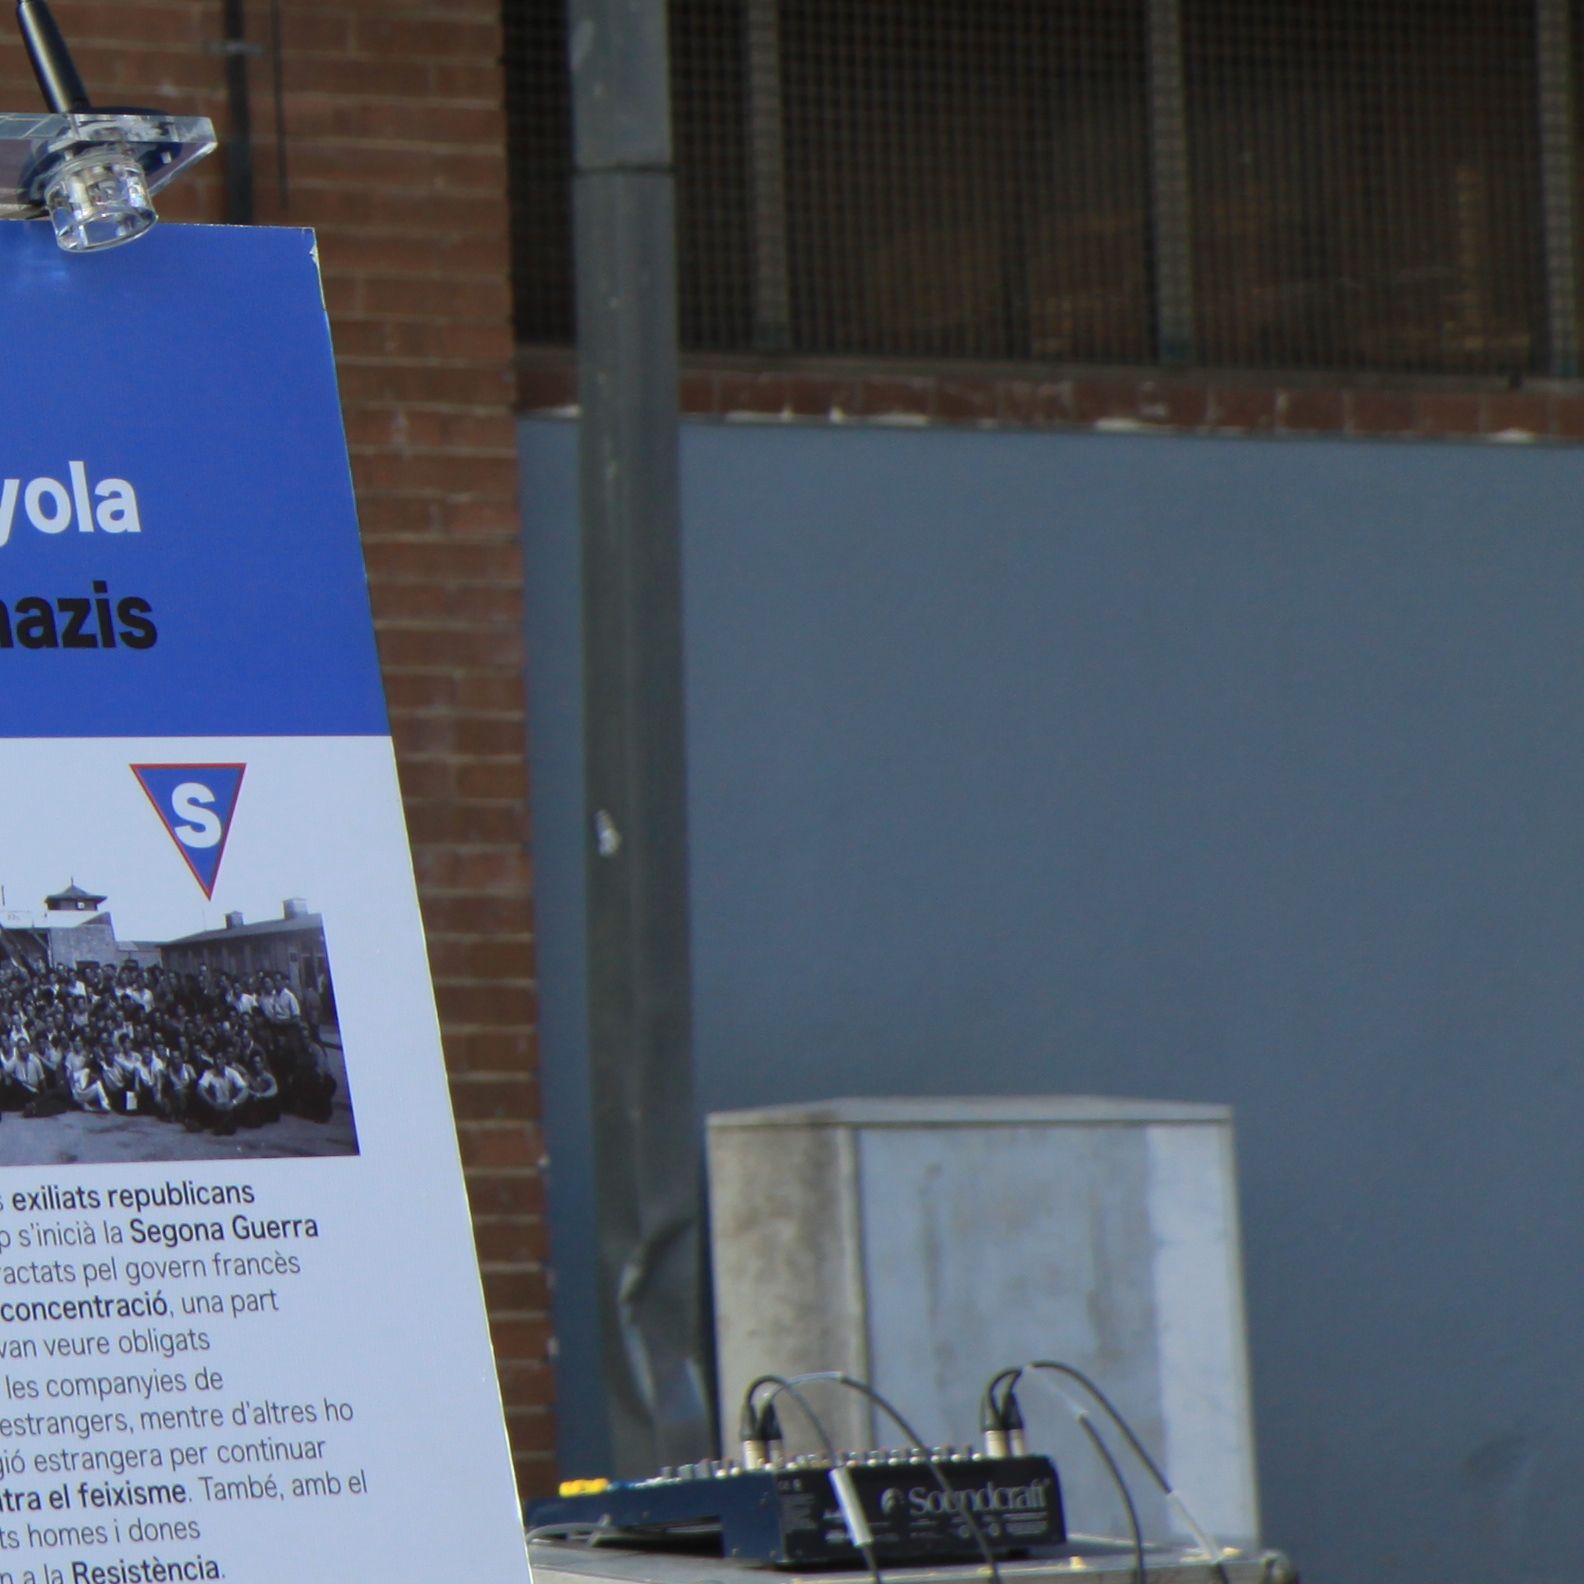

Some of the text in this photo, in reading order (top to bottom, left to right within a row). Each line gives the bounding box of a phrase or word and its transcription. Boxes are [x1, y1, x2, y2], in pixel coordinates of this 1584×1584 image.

[170, 782, 223, 848] S
[12, 1183, 101, 1212] exiliats
[107, 1180, 256, 1212] republicans
[19, 1220, 97, 1248] s'inicià
[103, 1220, 123, 1244] la
[129, 1217, 224, 1248] Segona
[231, 1215, 319, 1240] Guerra
[83, 1256, 118, 1287] pel
[125, 1259, 207, 1286] govern
[212, 1250, 301, 1277] francès
[0, 1289, 175, 1322] concentració,
[182, 1293, 224, 1314] una
[231, 1288, 279, 1318] part
[43, 1334, 110, 1357] veure
[118, 1328, 211, 1358] obligats
[5, 1375, 39, 1400] les
[46, 1368, 187, 1401] companyies
[194, 1366, 223, 1391] de
[0, 1412, 135, 1440] estrangers,
[140, 1405, 224, 1430] mentre
[231, 1400, 317, 1426] d'altres
[323, 1397, 354, 1421] ho
[33, 1447, 163, 1475] estrangera
[170, 1445, 208, 1471] per
[217, 1436, 326, 1464] continuar
[48, 1483, 70, 1509] el
[77, 1480, 193, 1509] feixisme.
[197, 1473, 285, 1501] També,
[291, 1471, 342, 1497] amb
[348, 1469, 368, 1495] el
[27, 1523, 108, 1548] homes
[113, 1518, 121, 1543] i
[128, 1517, 201, 1542] dones
[24, 1571, 37, 1584] a
[43, 1563, 63, 1584] la
[71, 1554, 226, 1584] Resistència.
